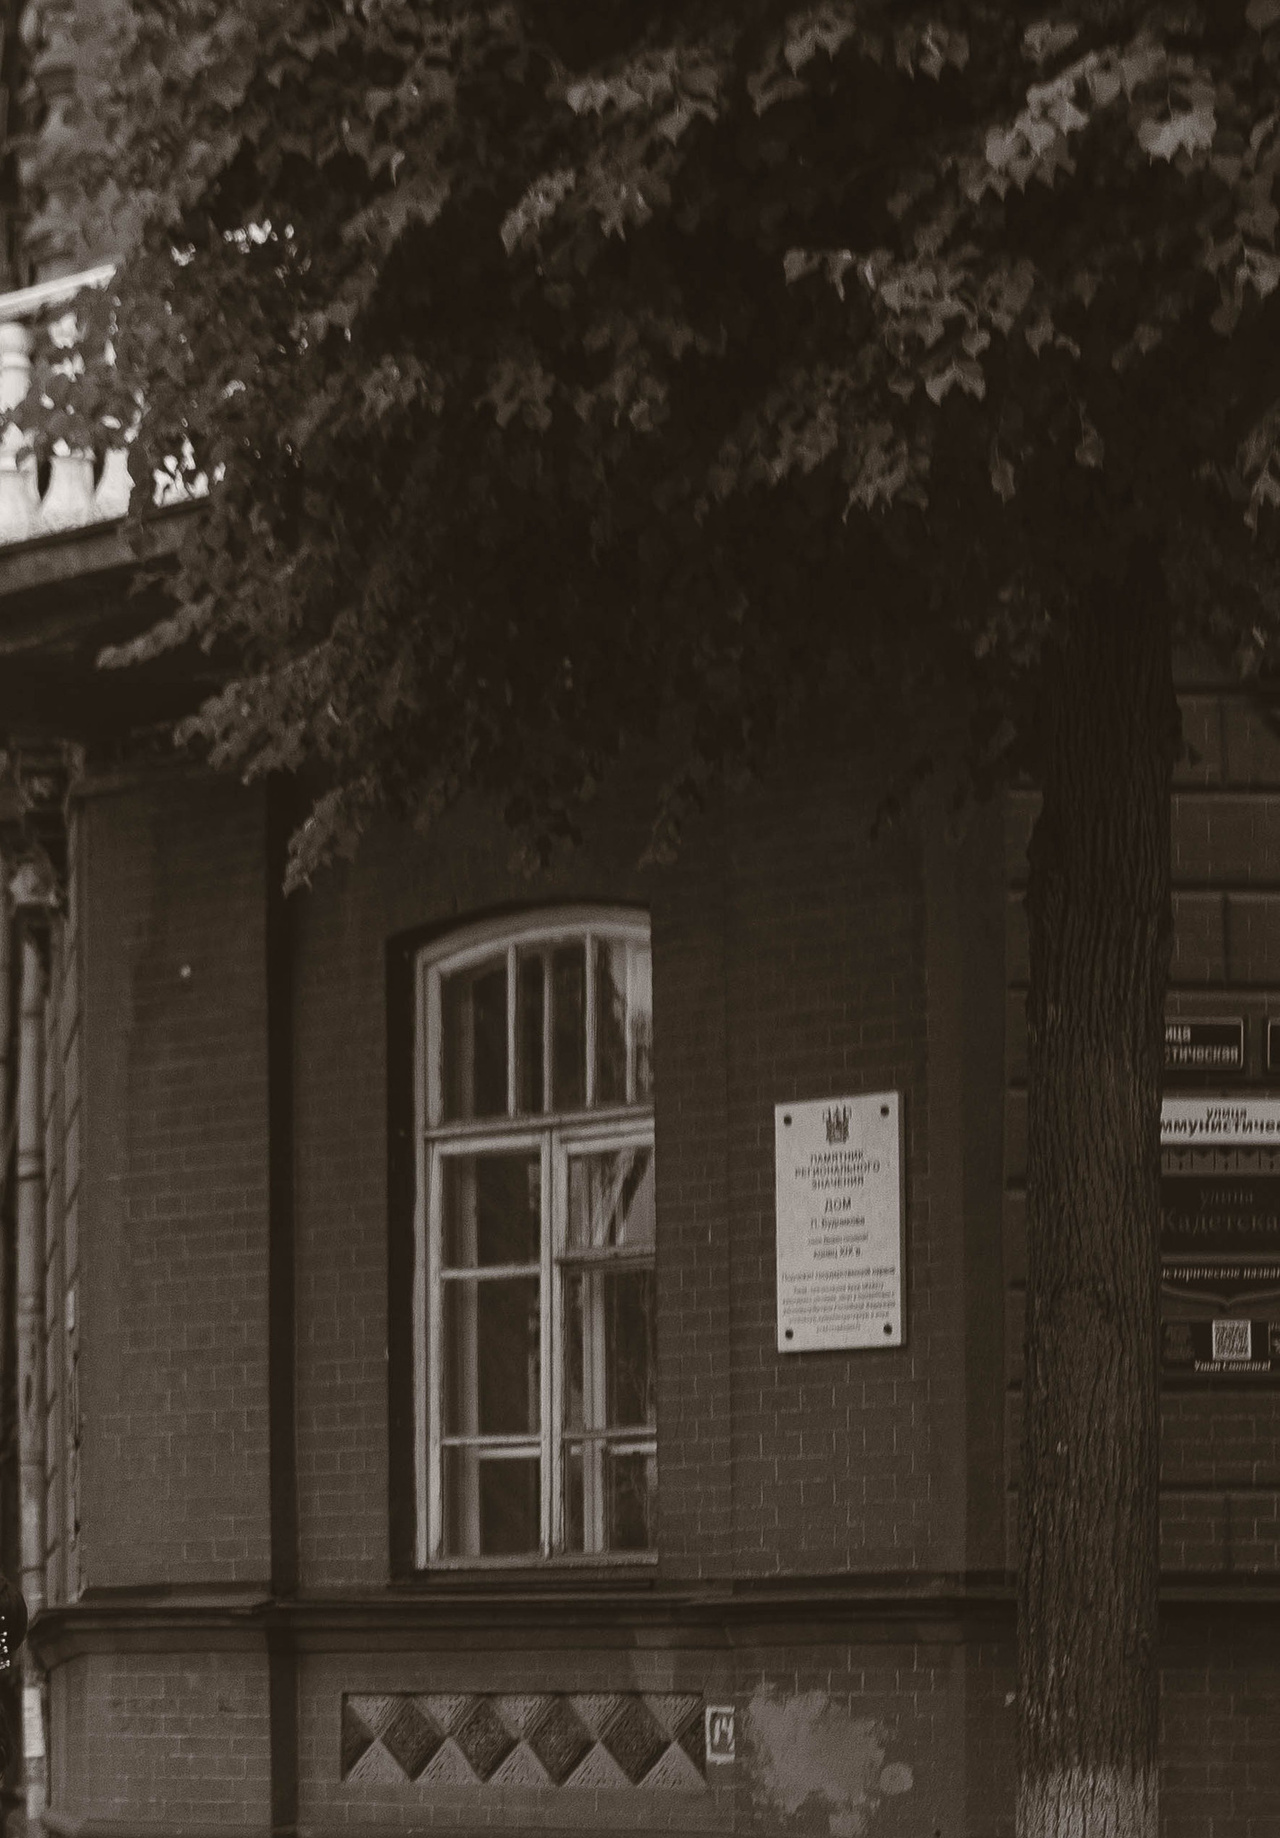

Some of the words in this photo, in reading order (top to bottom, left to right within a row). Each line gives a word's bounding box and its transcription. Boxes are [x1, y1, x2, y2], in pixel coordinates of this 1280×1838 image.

[1206, 1107, 1247, 1122] улица
[824, 1196, 853, 1214] ДОМ
[1200, 1189, 1253, 1211] улица
